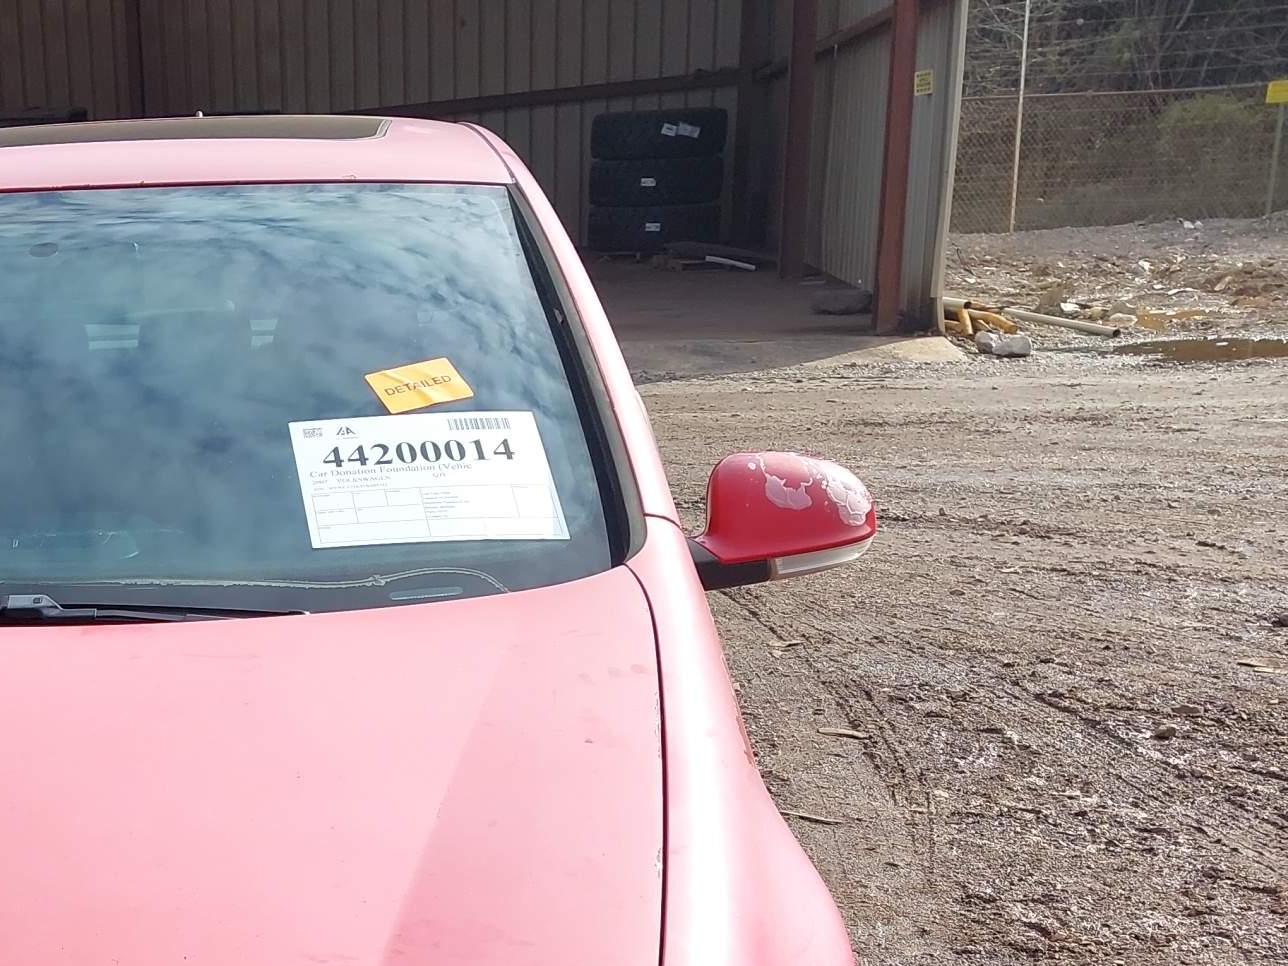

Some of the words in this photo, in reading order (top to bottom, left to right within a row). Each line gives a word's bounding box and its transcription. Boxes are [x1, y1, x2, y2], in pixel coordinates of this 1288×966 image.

[384, 374, 452, 396] DETAILED
[323, 438, 515, 468] 44200014
[309, 470, 328, 479] Car
[330, 467, 377, 477] Donation
